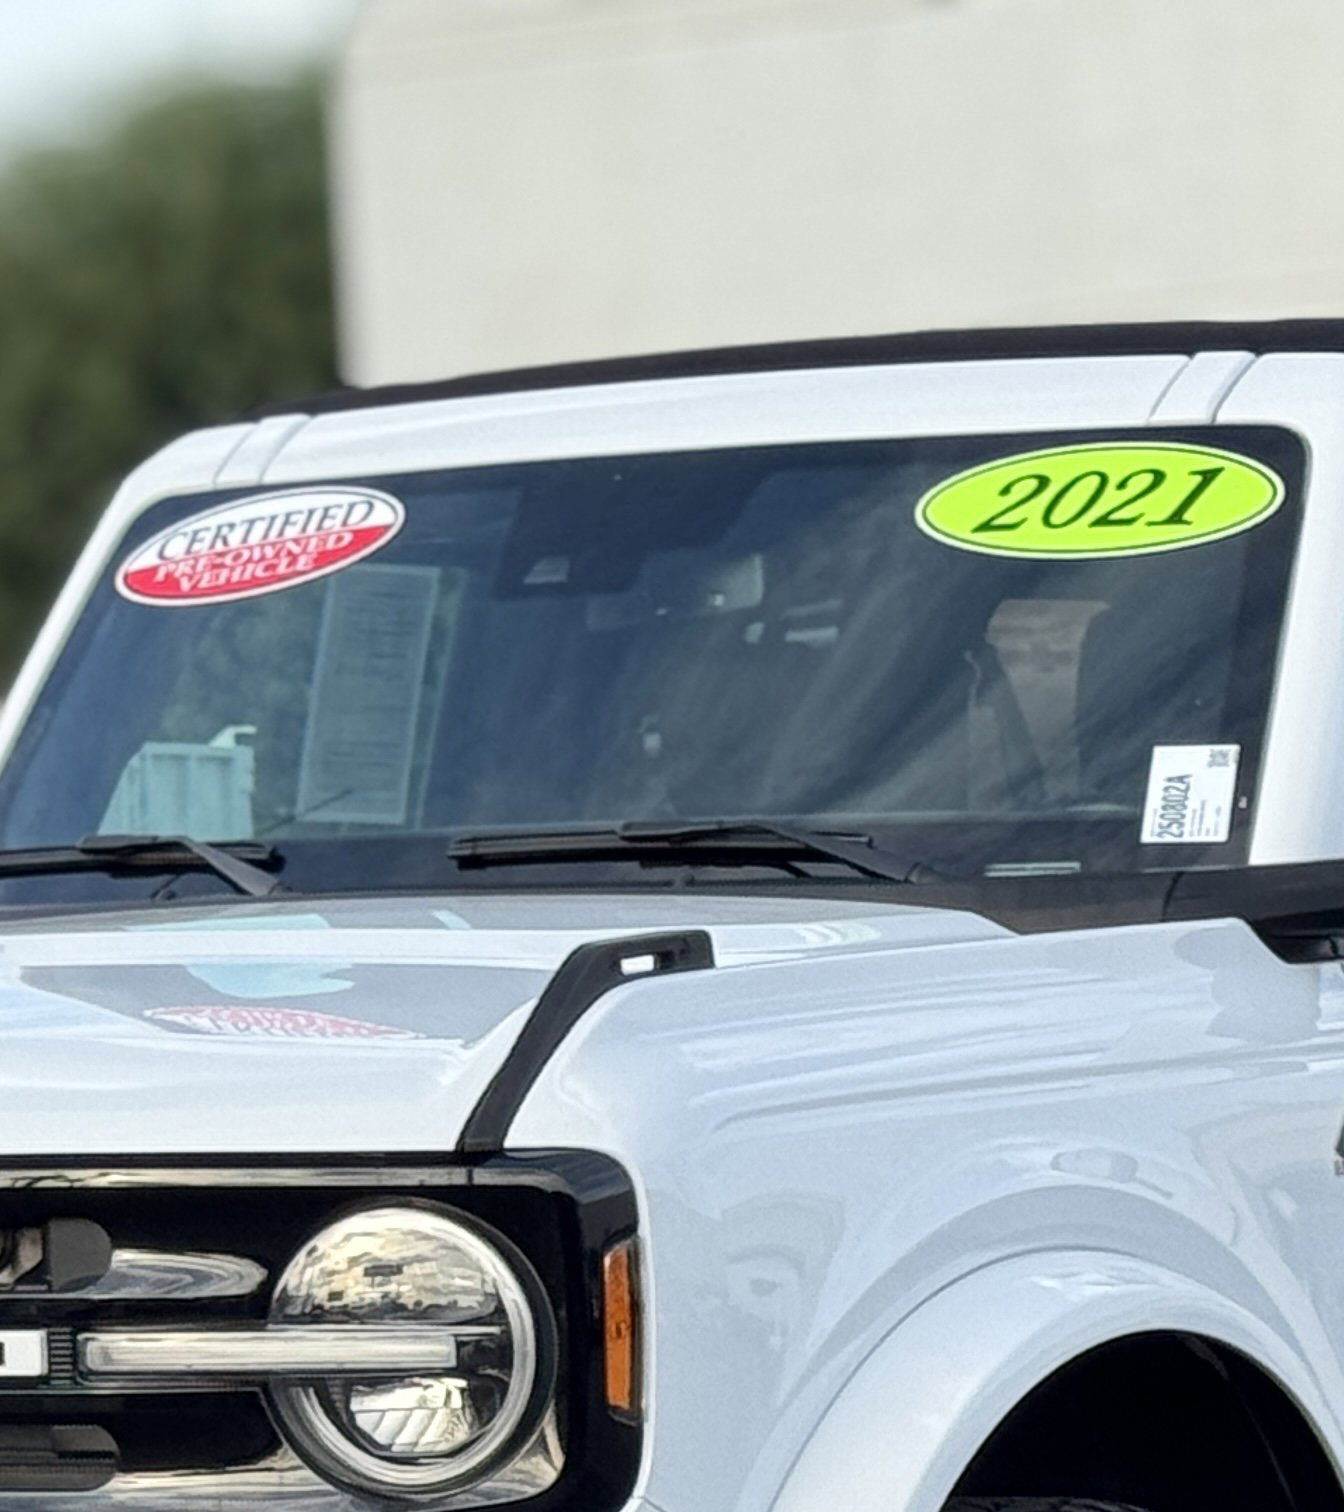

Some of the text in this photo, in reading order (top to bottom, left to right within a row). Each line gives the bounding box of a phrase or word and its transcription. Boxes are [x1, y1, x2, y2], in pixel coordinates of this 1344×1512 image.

[970, 466, 1226, 534] 2021
[154, 531, 355, 583] PRE-OWNED
[157, 499, 375, 562] CERTIFIED
[178, 551, 316, 593] VEHICLE
